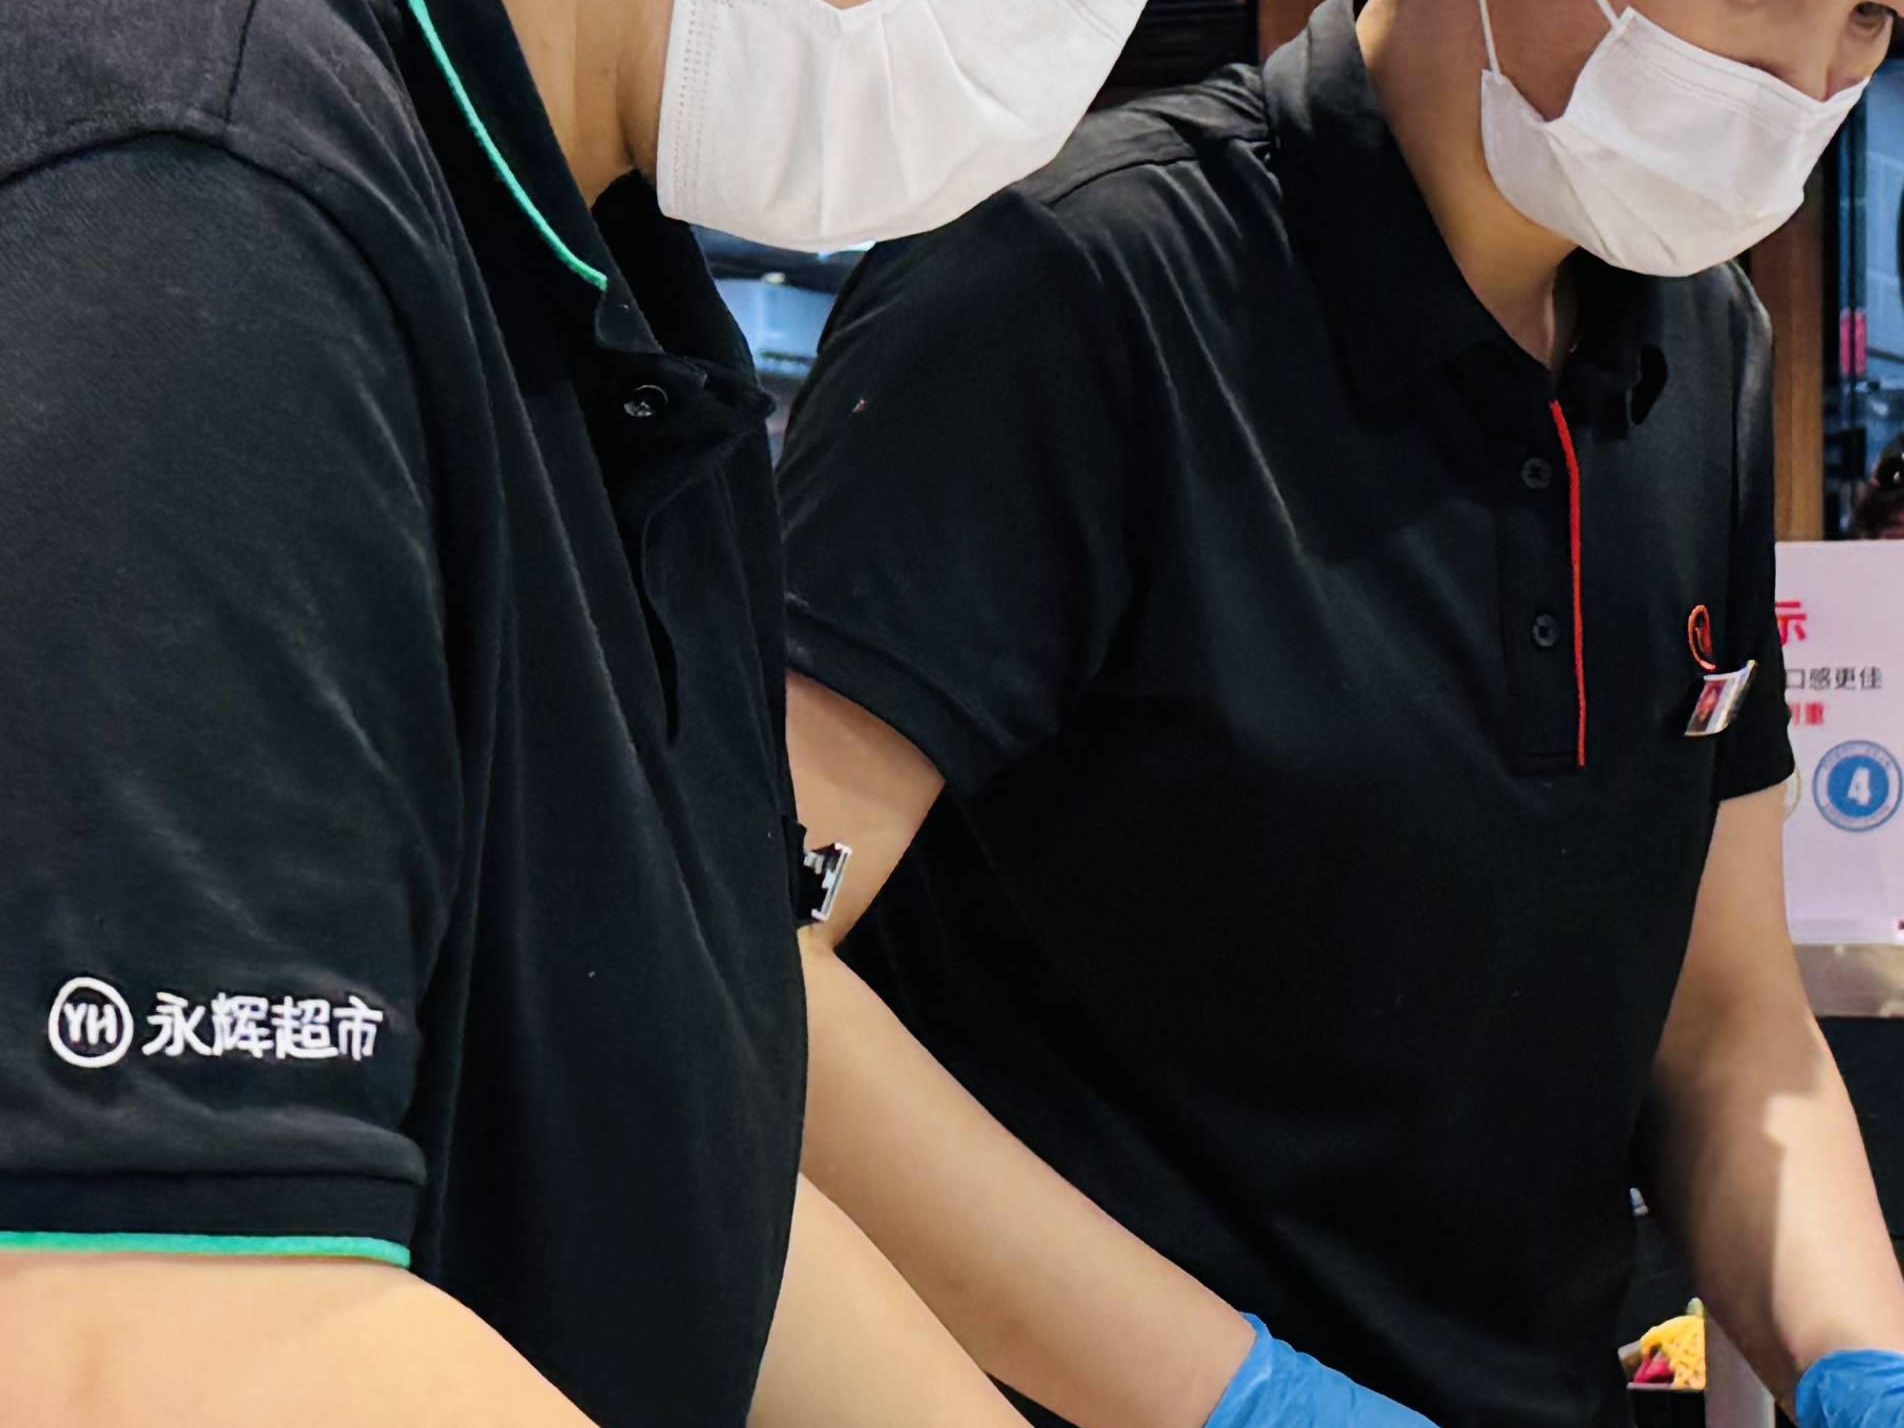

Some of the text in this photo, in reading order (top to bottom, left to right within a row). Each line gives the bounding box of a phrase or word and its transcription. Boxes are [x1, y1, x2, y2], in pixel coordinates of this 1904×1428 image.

[1785, 665, 1883, 691] 口感更佳
[142, 991, 384, 1062] 永辉超市
